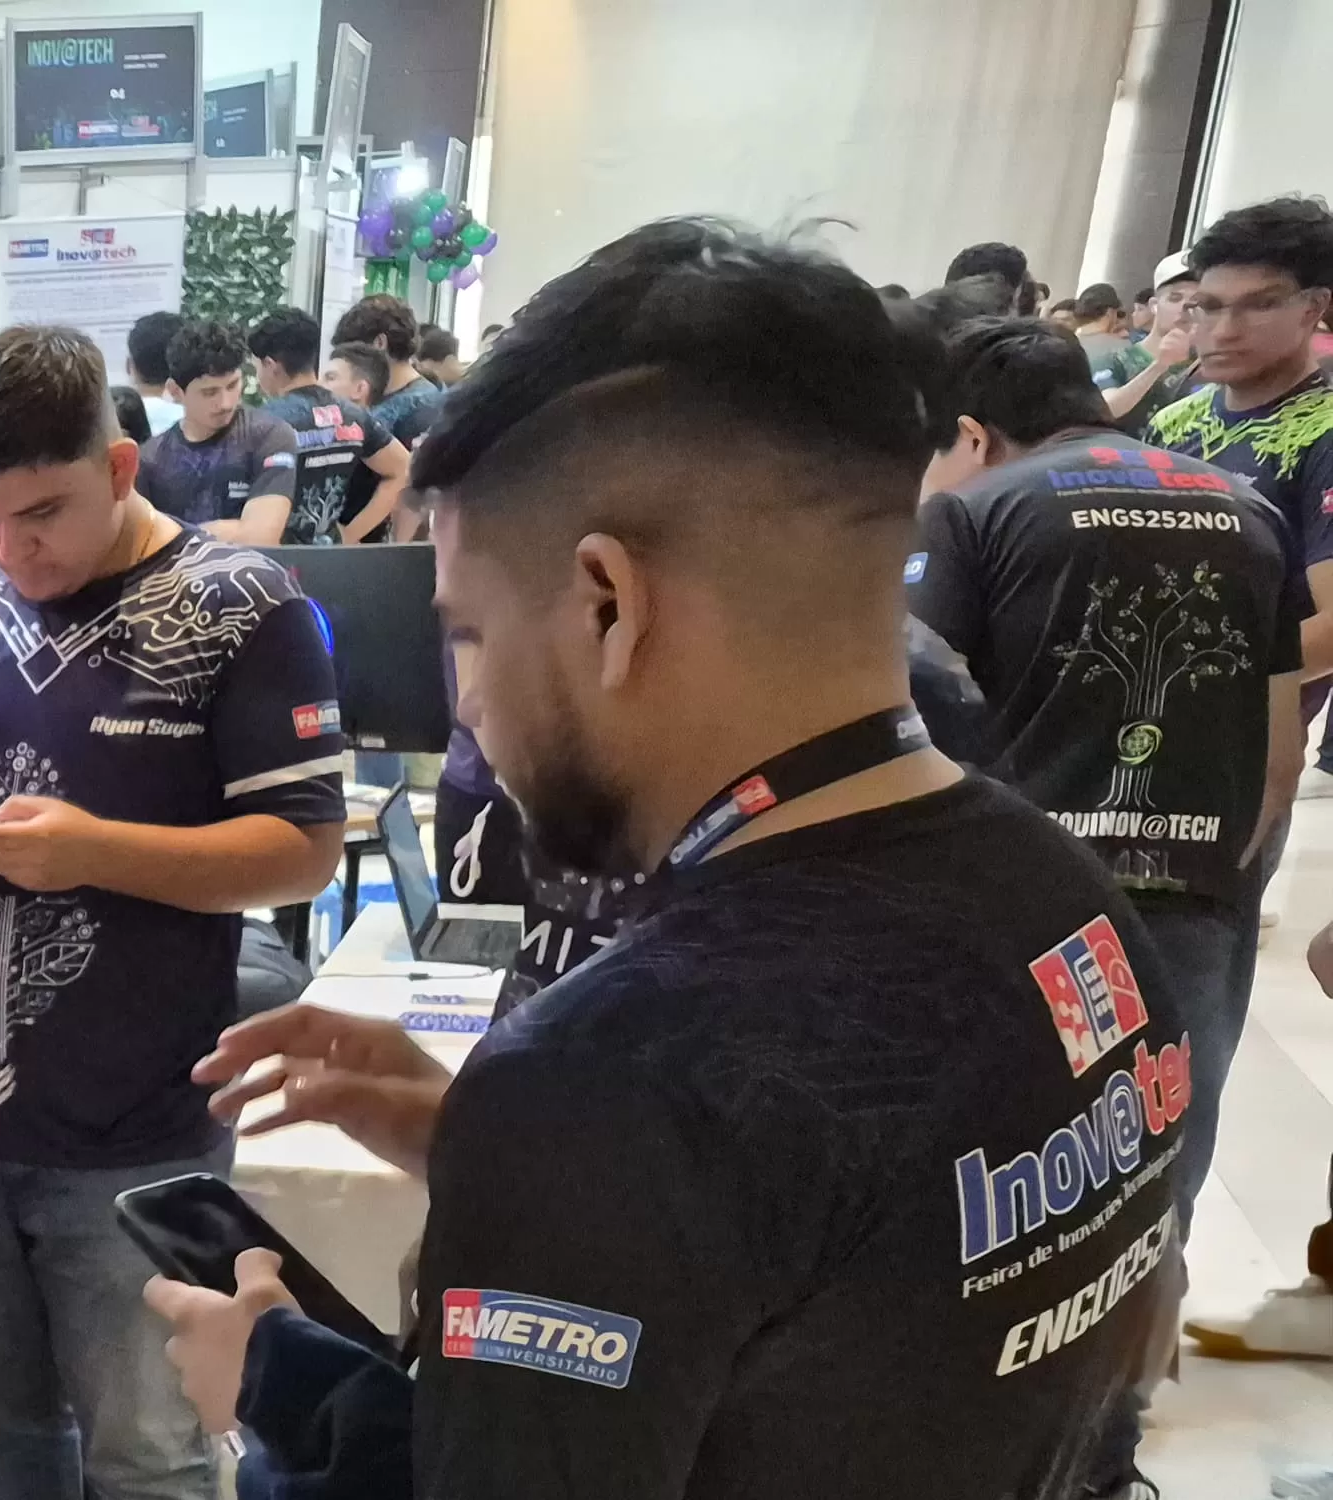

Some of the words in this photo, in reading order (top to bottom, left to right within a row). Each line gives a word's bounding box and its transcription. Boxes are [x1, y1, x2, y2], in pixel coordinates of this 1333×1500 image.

[27, 38, 114, 67] INOV@TECH
[1072, 508, 1241, 533] ENGS252N01
[90, 716, 145, 736] Ryan
[962, 1259, 1023, 1299] Feira
[1028, 1245, 1054, 1270] de
[447, 1306, 628, 1364] FAMETRO
[485, 1344, 619, 1383] UNIVERSITÁRIO
